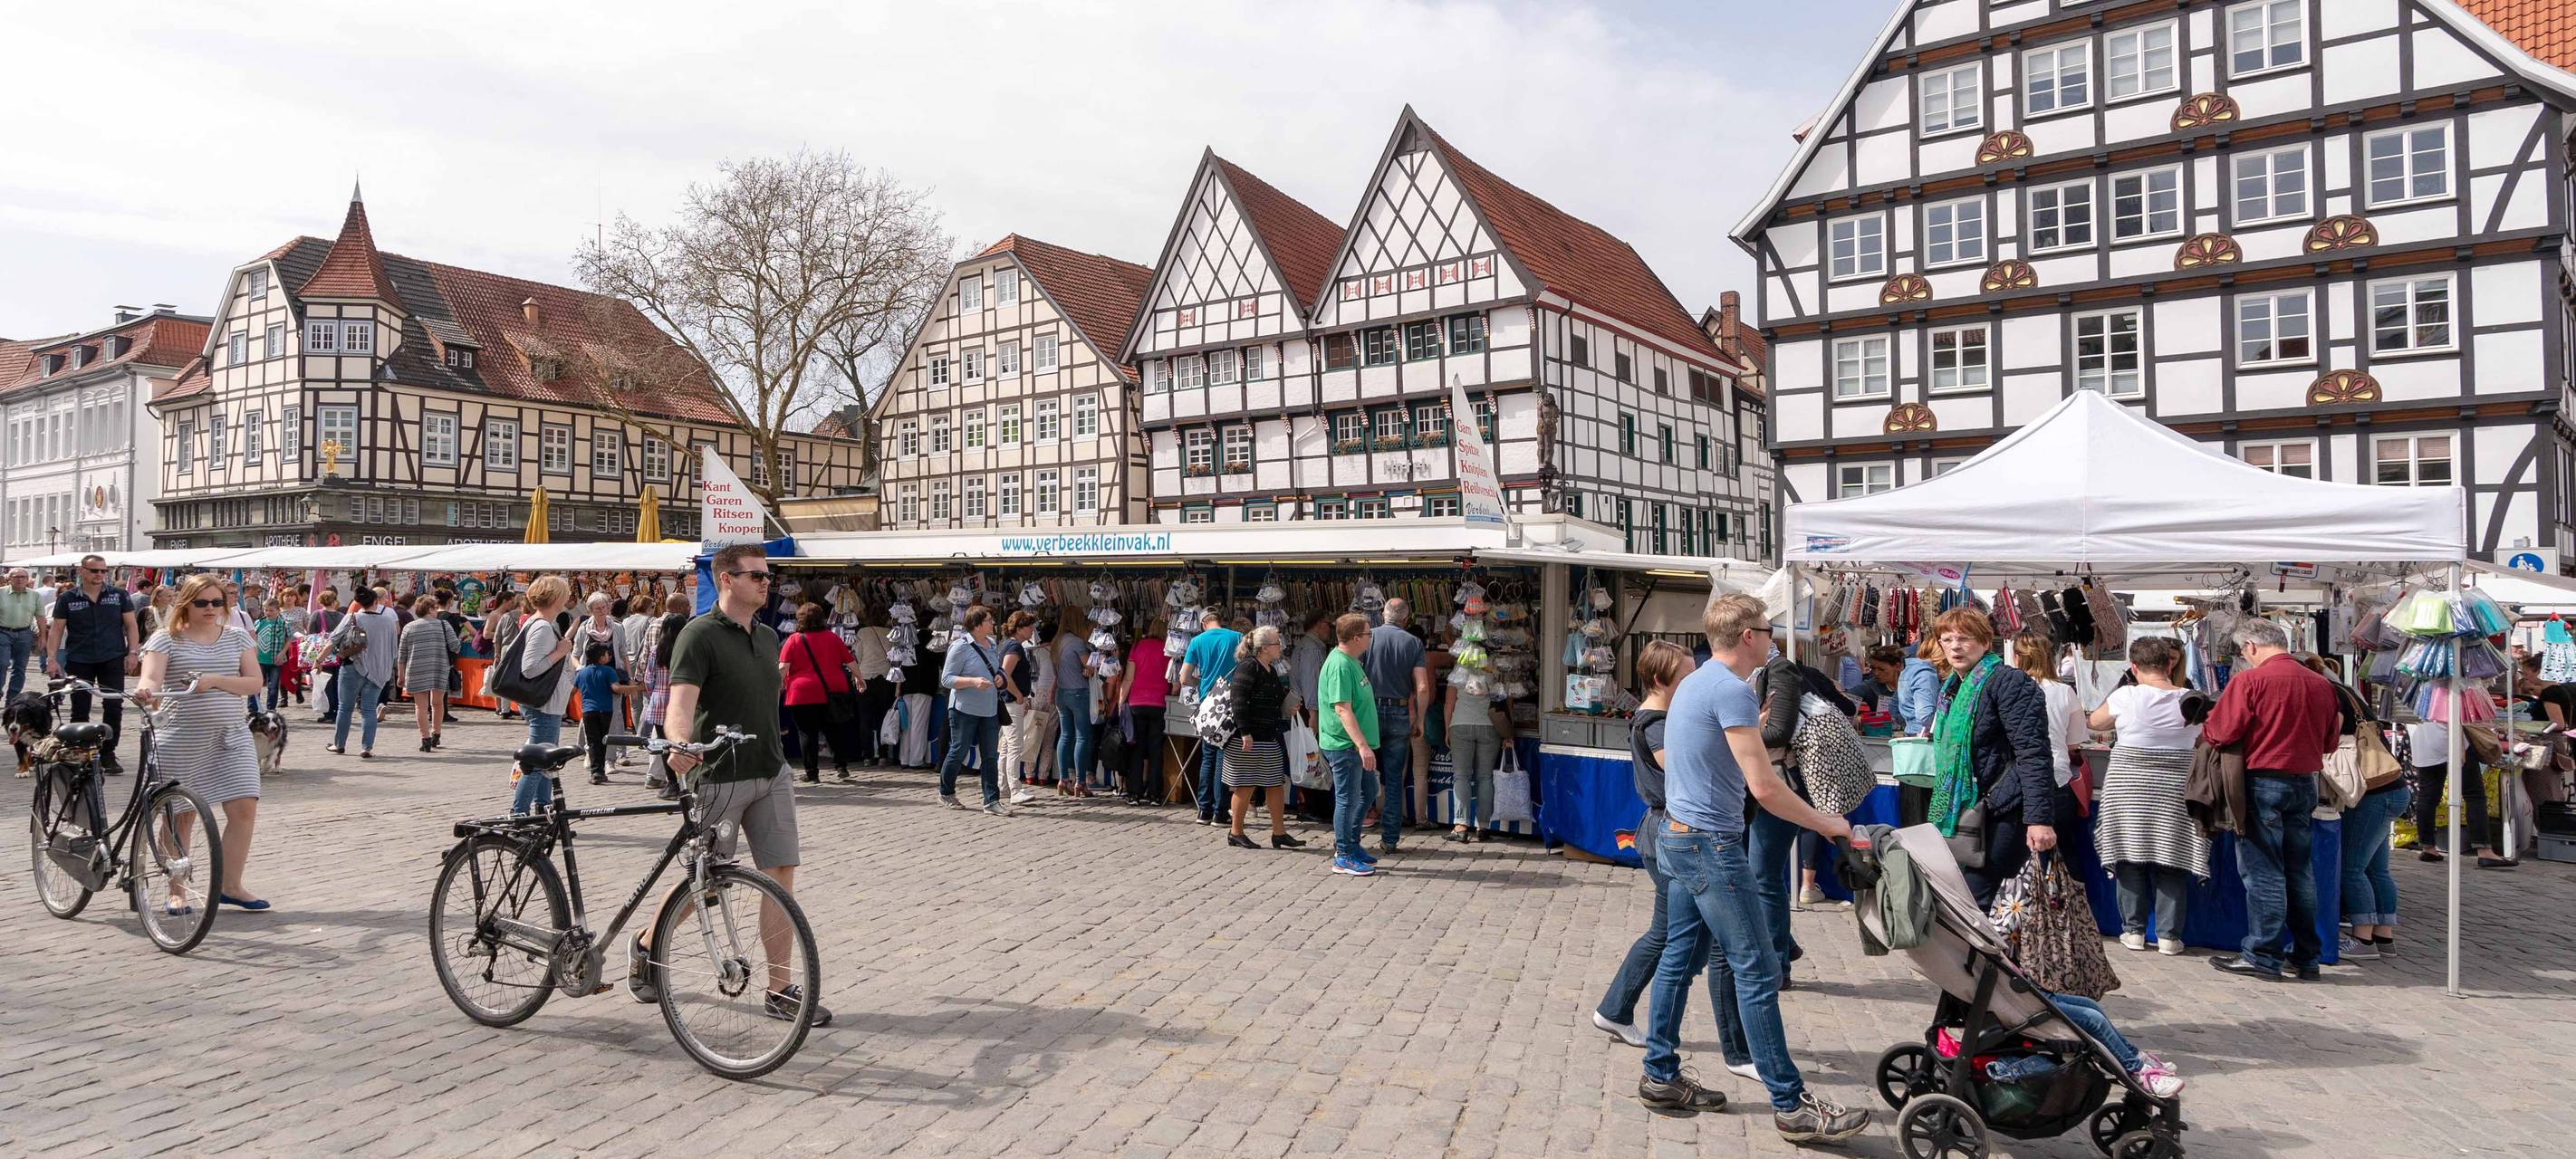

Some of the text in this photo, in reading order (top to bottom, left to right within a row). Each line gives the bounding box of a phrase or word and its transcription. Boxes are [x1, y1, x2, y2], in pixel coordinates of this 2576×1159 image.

[703, 481, 731, 492] Kant
[706, 494, 742, 505] Garen
[713, 508, 753, 519] Ritsen
[718, 522, 763, 535] Knopen
[264, 534, 300, 548] APOTHEKE
[1002, 532, 1170, 551] www.verbeekkleinvak.nl
